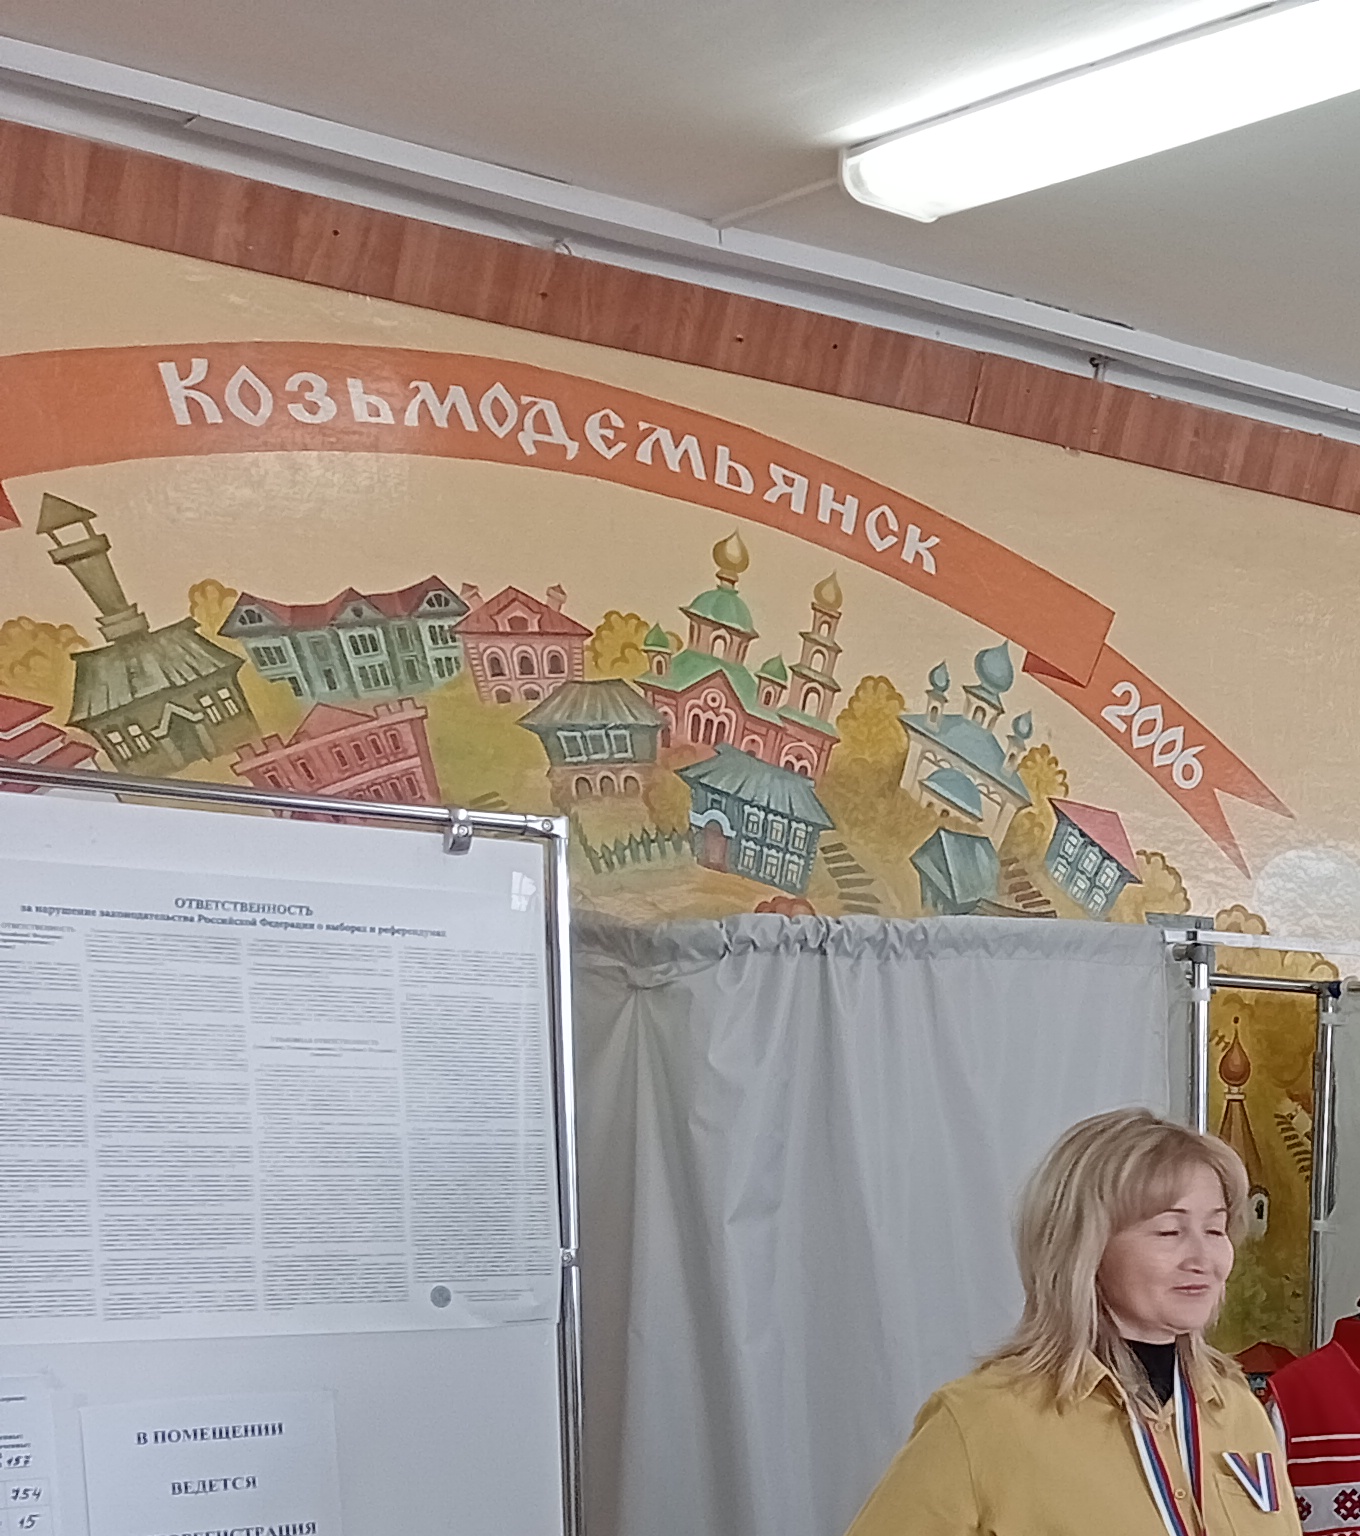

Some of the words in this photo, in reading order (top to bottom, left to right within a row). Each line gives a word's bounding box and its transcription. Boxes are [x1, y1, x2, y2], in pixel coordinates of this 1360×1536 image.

[1100, 681, 1205, 790] 2006
[174, 896, 314, 917] ОТВЕТСТВЕННОСТЬ
[136, 1431, 149, 1446] В
[153, 1421, 284, 1445] ПОМЕЩЕНИИ
[171, 1475, 258, 1496] ВЕДЕТСЯ
